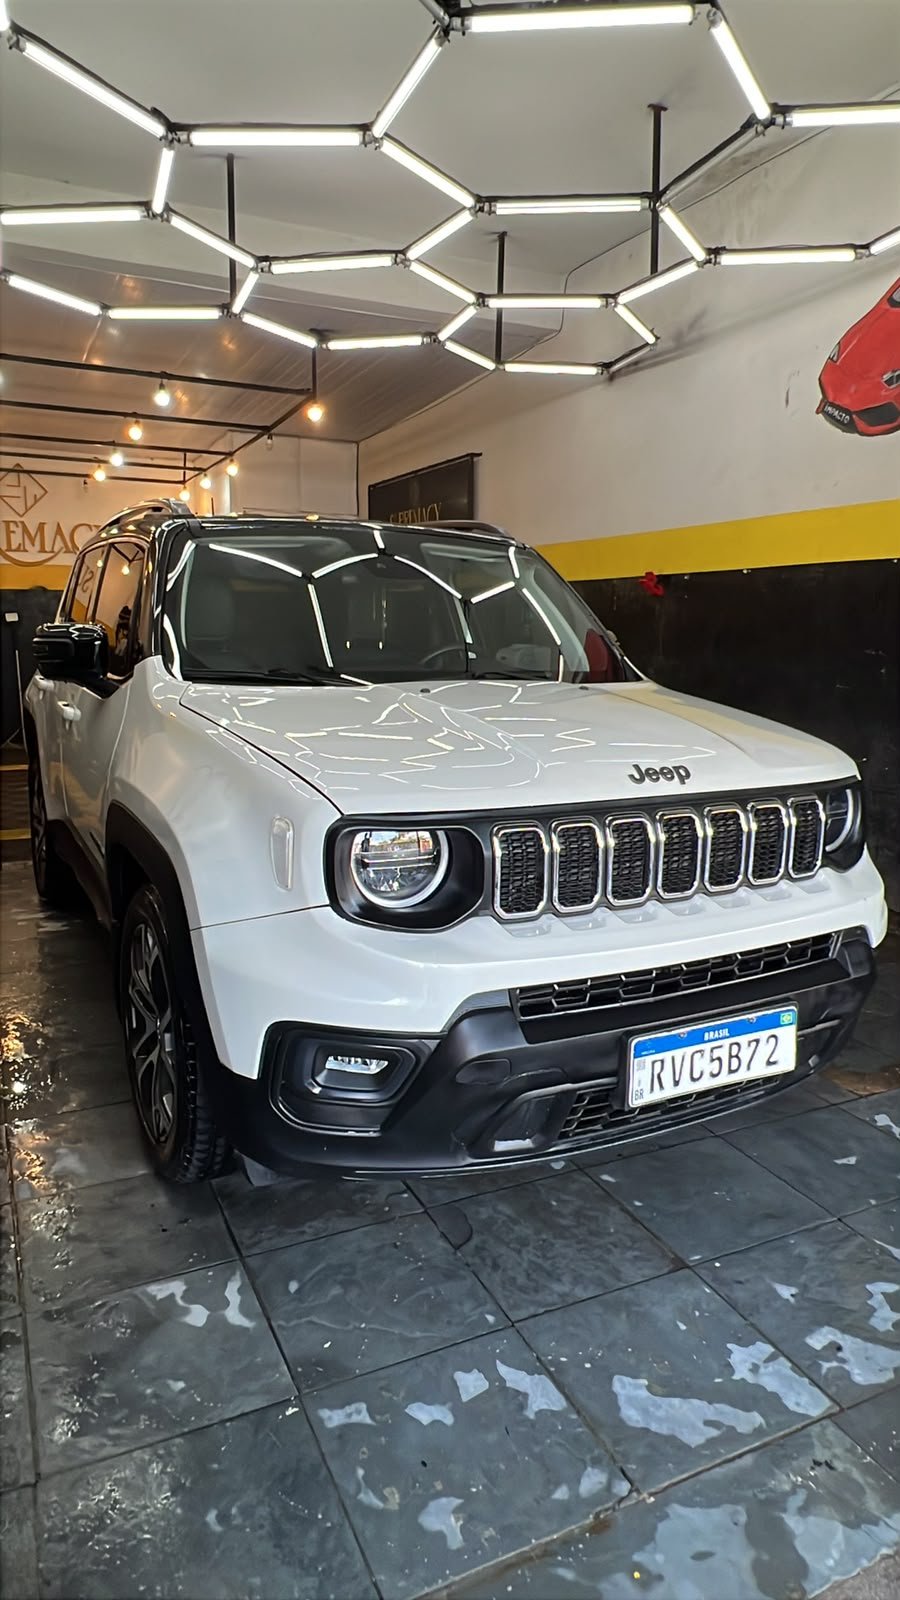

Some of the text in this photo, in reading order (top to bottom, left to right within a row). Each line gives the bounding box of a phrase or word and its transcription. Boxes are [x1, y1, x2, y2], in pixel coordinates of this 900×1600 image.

[824, 403, 850, 424] IMPACTO
[0, 520, 103, 558] EMAC
[627, 763, 692, 785] Jeep
[703, 1028, 730, 1041] BRASIL
[649, 1033, 779, 1094] RVC5B72
